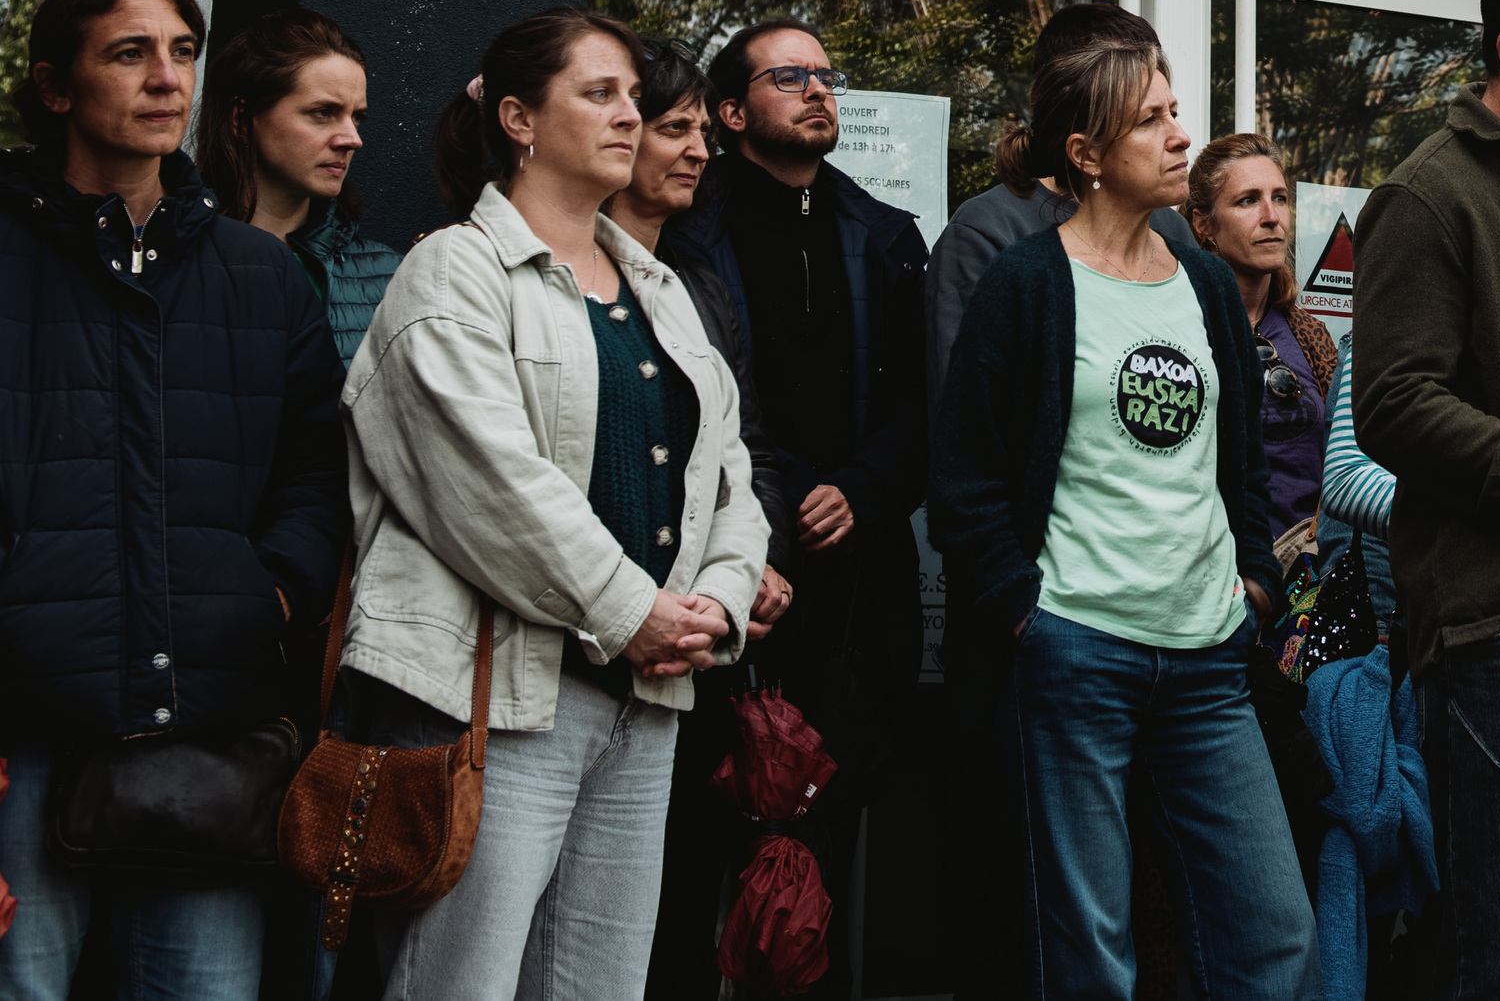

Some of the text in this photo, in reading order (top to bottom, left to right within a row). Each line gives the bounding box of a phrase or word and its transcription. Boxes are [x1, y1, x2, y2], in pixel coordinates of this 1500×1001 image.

[839, 106, 878, 118] OUVERT
[841, 124, 890, 136] VENDREDI
[838, 141, 896, 153] de 13h à 17h
[1320, 273, 1353, 285] VIGIPIR
[1300, 295, 1342, 308] URGENCE
[1129, 354, 1198, 387] BAXOA
[1122, 370, 1198, 413] EUSKA
[1126, 398, 1190, 437] RAZ!
